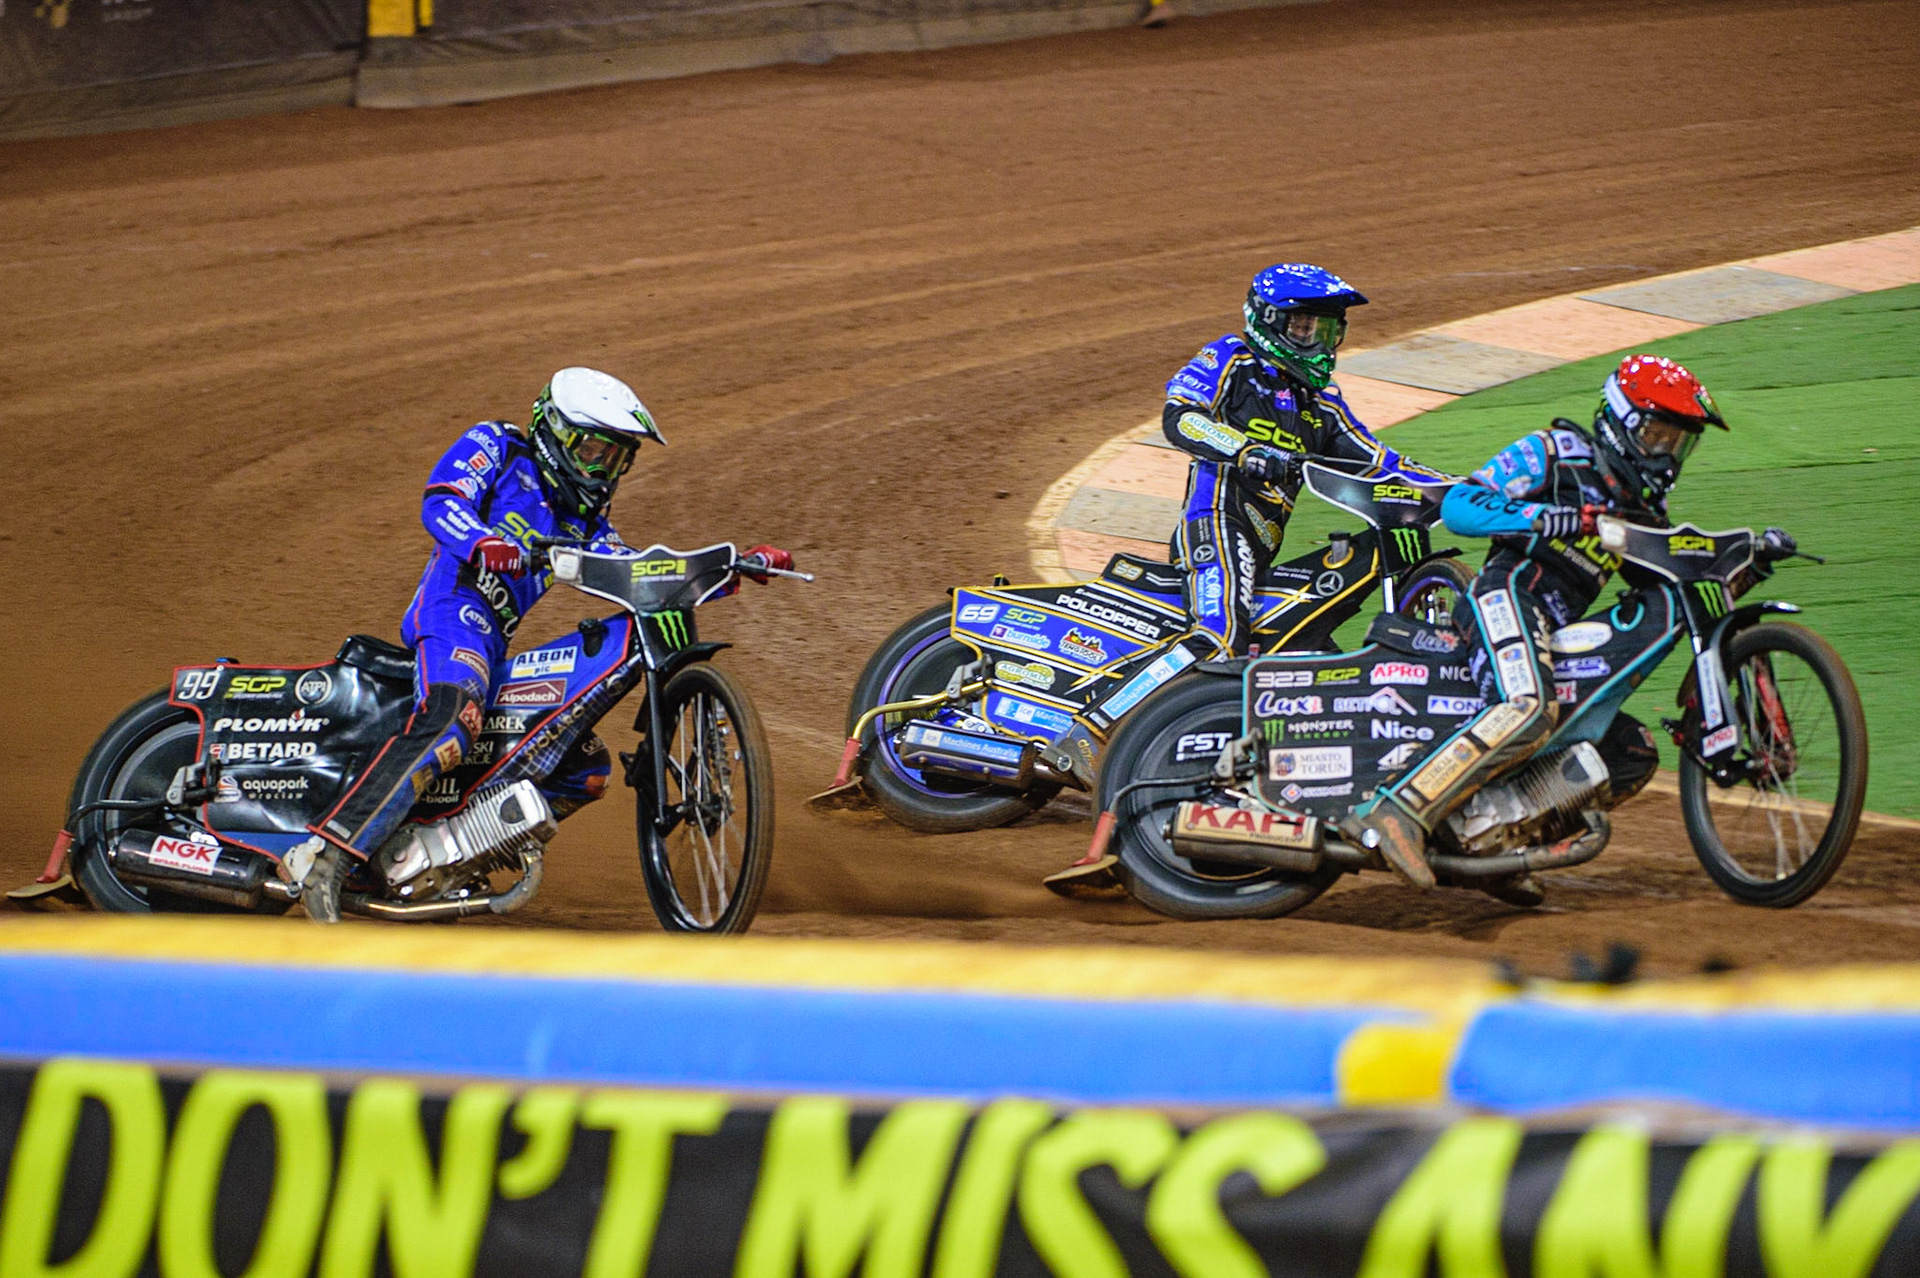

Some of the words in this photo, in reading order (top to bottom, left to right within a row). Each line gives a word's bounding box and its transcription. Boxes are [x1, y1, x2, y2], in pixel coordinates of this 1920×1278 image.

[1187, 415, 1237, 449] AGROMIX
[1244, 418, 1307, 453] SG
[632, 559, 677, 577] SGP
[1236, 531, 1259, 611] HAGON
[959, 603, 1000, 623] 69
[1003, 607, 1048, 625] SGP
[1056, 594, 1161, 639] POLCOPPER
[1007, 626, 1050, 648] burnside
[516, 648, 575, 666] ALBON
[1001, 663, 1050, 681] AGROMIX
[1255, 670, 1314, 689] 323
[1314, 667, 1361, 683] SGP
[1373, 664, 1427, 678] APRO
[1440, 665, 1472, 681] NIC
[178, 671, 221, 700] 99
[228, 676, 287, 692] SGP
[500, 690, 557, 704] Alpodach
[1287, 719, 1355, 733] MONSTER
[1371, 717, 1435, 741] Nice
[227, 741, 317, 760] BETARD
[941, 736, 981, 752] Machines
[981, 741, 1019, 759] Australia
[1177, 732, 1233, 753] FST
[242, 776, 309, 793] aquapark
[156, 838, 216, 863] NGK
[0, 1059, 731, 1278] DON'T
[735, 1096, 1328, 1278] MISS
